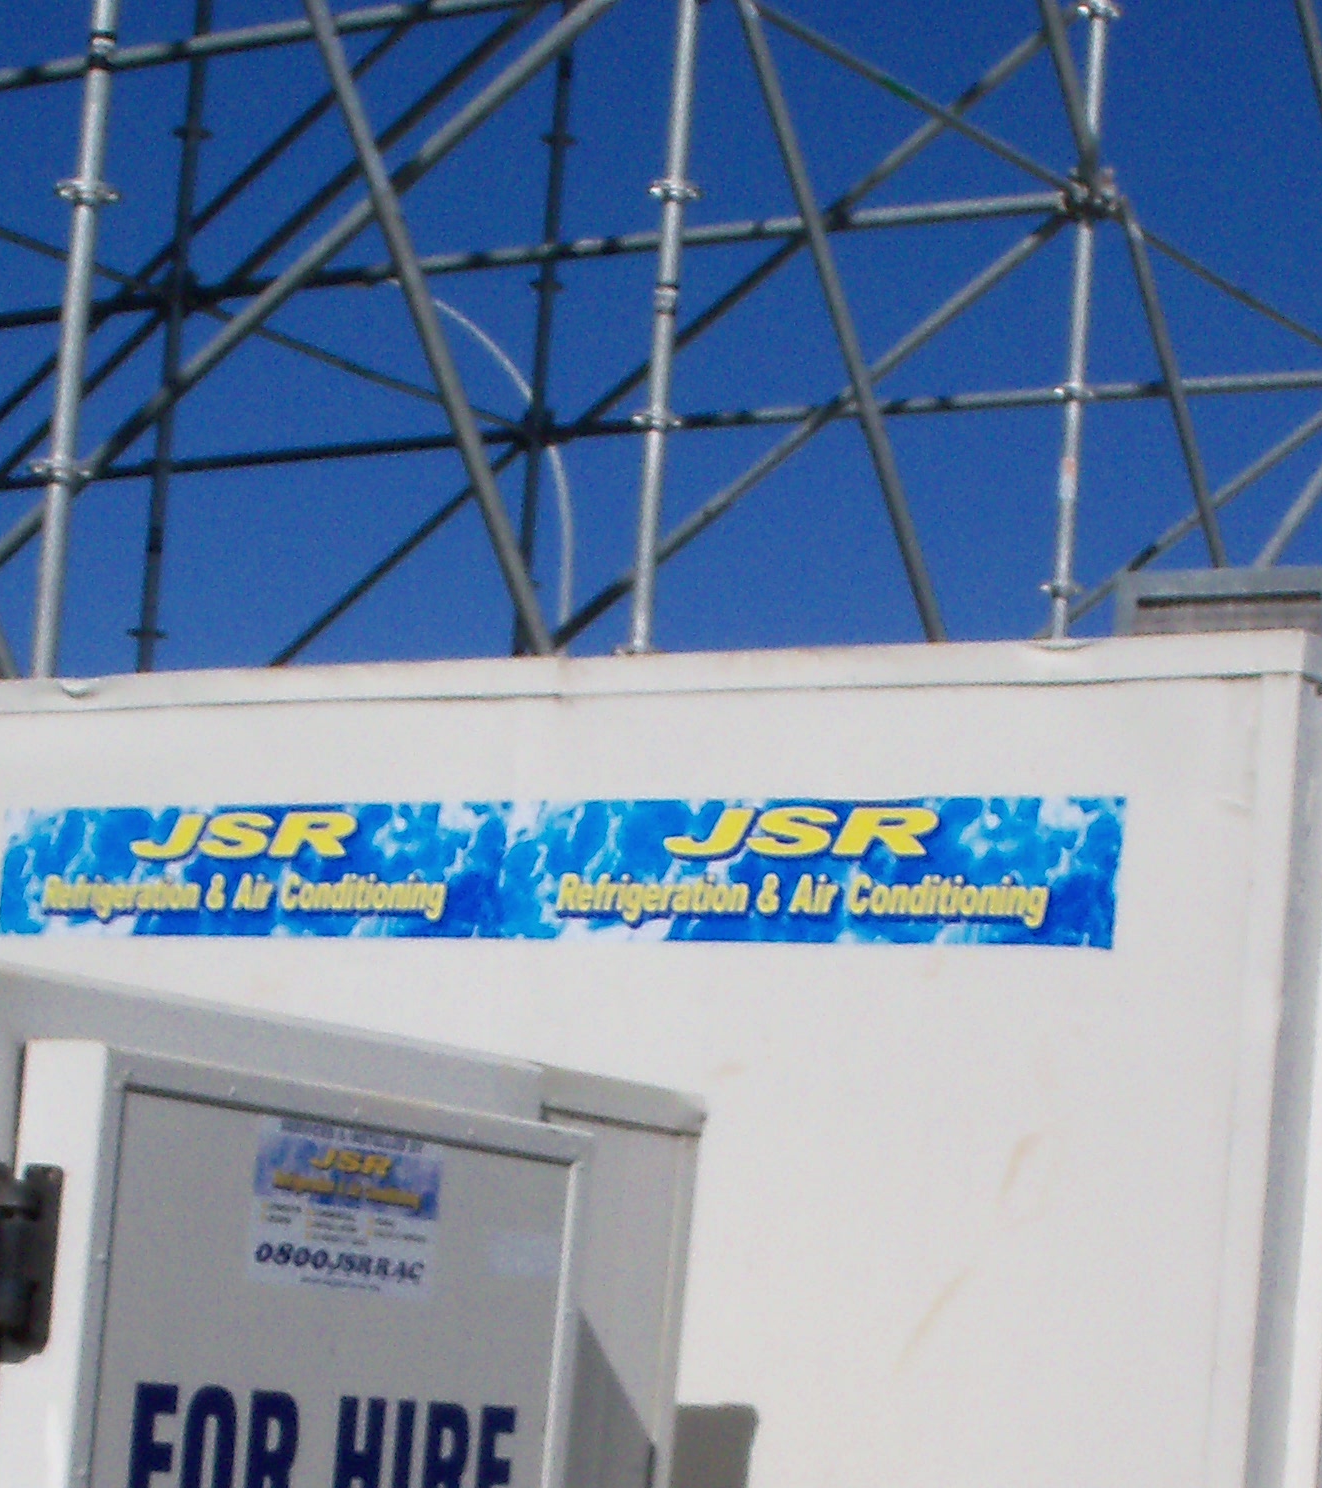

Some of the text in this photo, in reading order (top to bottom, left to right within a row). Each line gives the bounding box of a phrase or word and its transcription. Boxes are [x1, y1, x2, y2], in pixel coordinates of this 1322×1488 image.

[130, 811, 358, 860] JSR
[663, 806, 940, 859] JSR
[42, 873, 446, 921] Refrigeration & Air Conditioning
[557, 873, 1051, 928] Refrigeration & Air Conditioning
[309, 1148, 393, 1177] JSR
